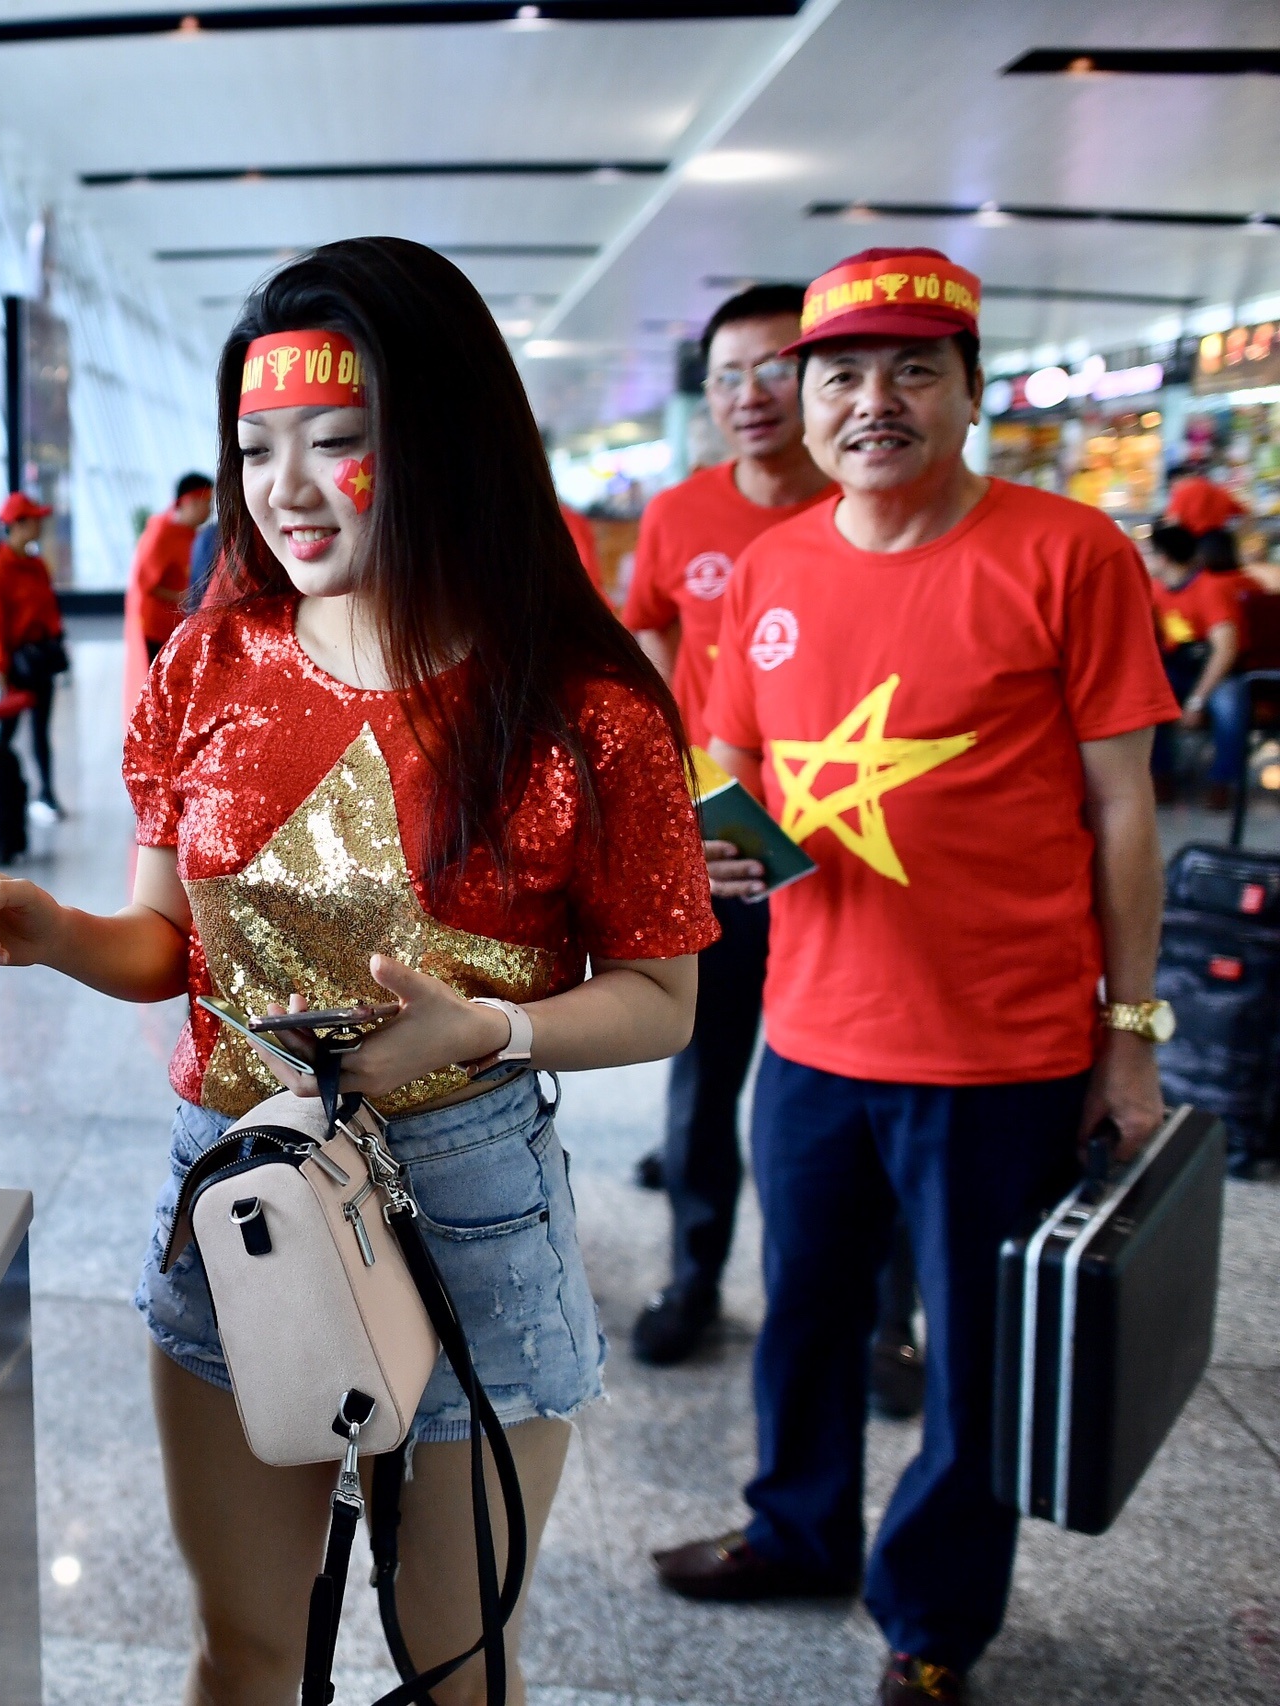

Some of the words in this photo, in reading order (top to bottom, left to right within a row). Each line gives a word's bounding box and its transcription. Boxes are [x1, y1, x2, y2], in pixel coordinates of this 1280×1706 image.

[826, 279, 873, 310] NAM
[914, 274, 940, 299] VÔ
[305, 342, 332, 384] VÔ
[338, 351, 366, 393] ĐỊ
